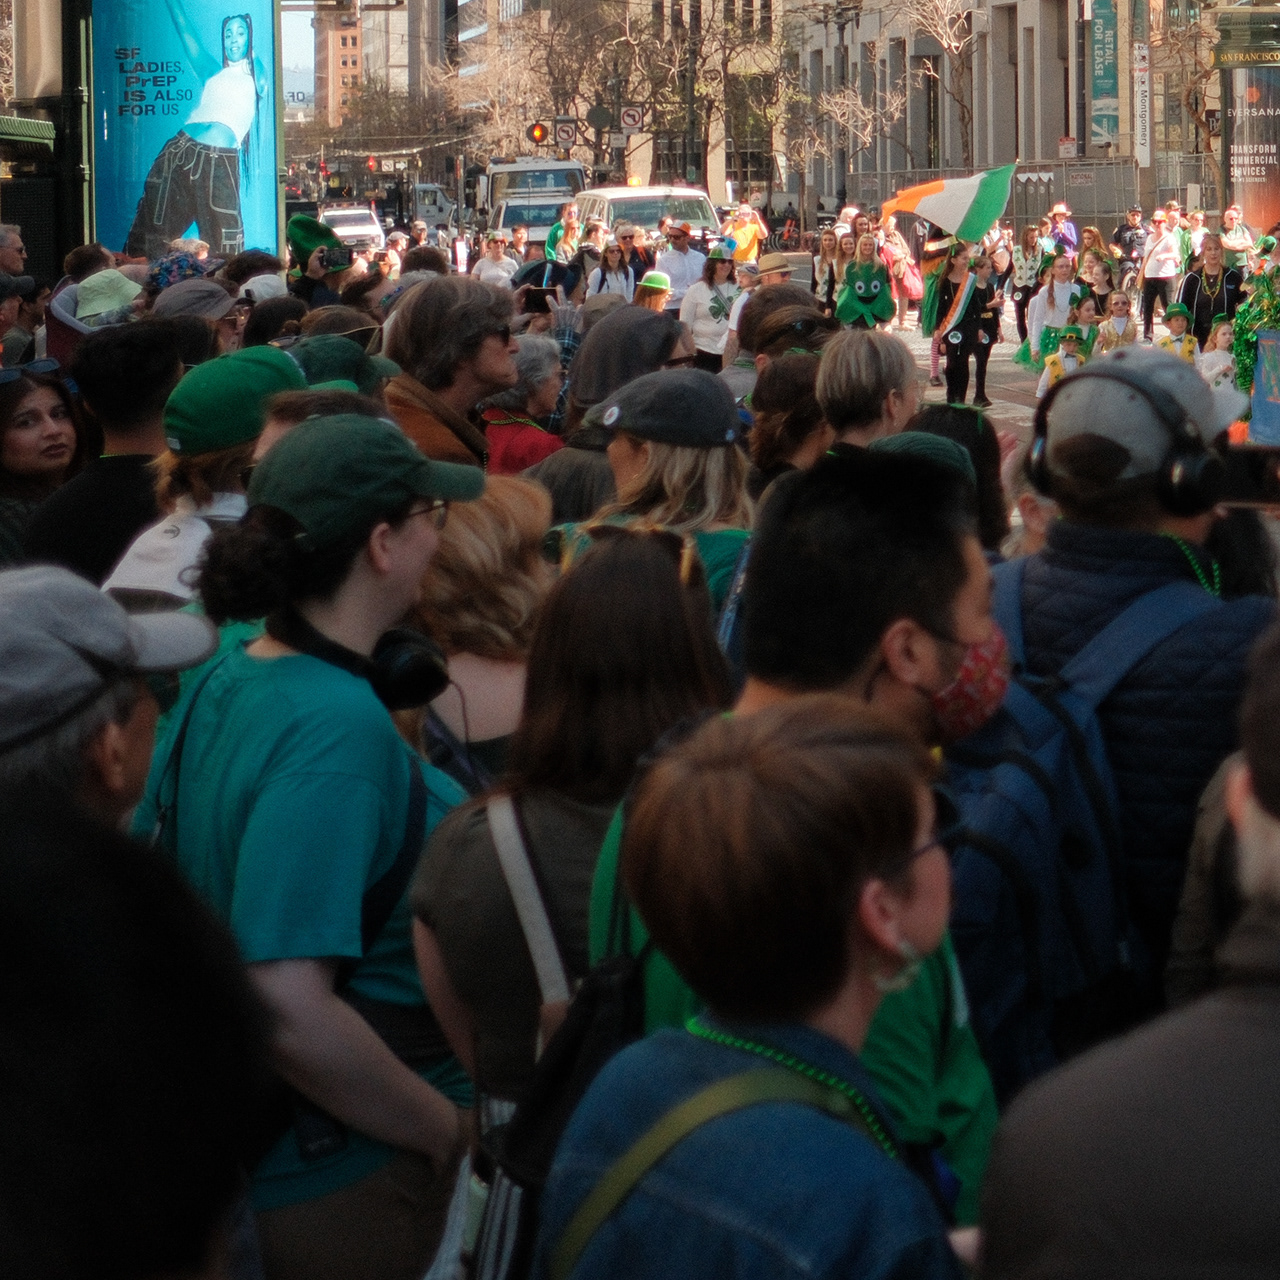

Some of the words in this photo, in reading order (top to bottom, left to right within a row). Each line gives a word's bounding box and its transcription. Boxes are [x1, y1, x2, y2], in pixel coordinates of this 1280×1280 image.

[1094, 19, 1104, 40] FOR
[115, 47, 141, 60] SF
[1105, 30, 1113, 65] RETAIL
[1094, 44, 1104, 76] LEASE
[1221, 53, 1233, 61] SAN
[1234, 52, 1280, 62] FRANCISCO
[119, 61, 184, 75] LADIES,
[126, 76, 177, 87] PrEP
[124, 90, 146, 102] IS
[154, 90, 193, 102] ALSO
[118, 104, 156, 116] FOR
[162, 104, 179, 116] US
[1139, 89, 1148, 147] Montgomery
[1230, 145, 1277, 154] TRANSFORM
[1230, 156, 1278, 165] COMMERCIAL
